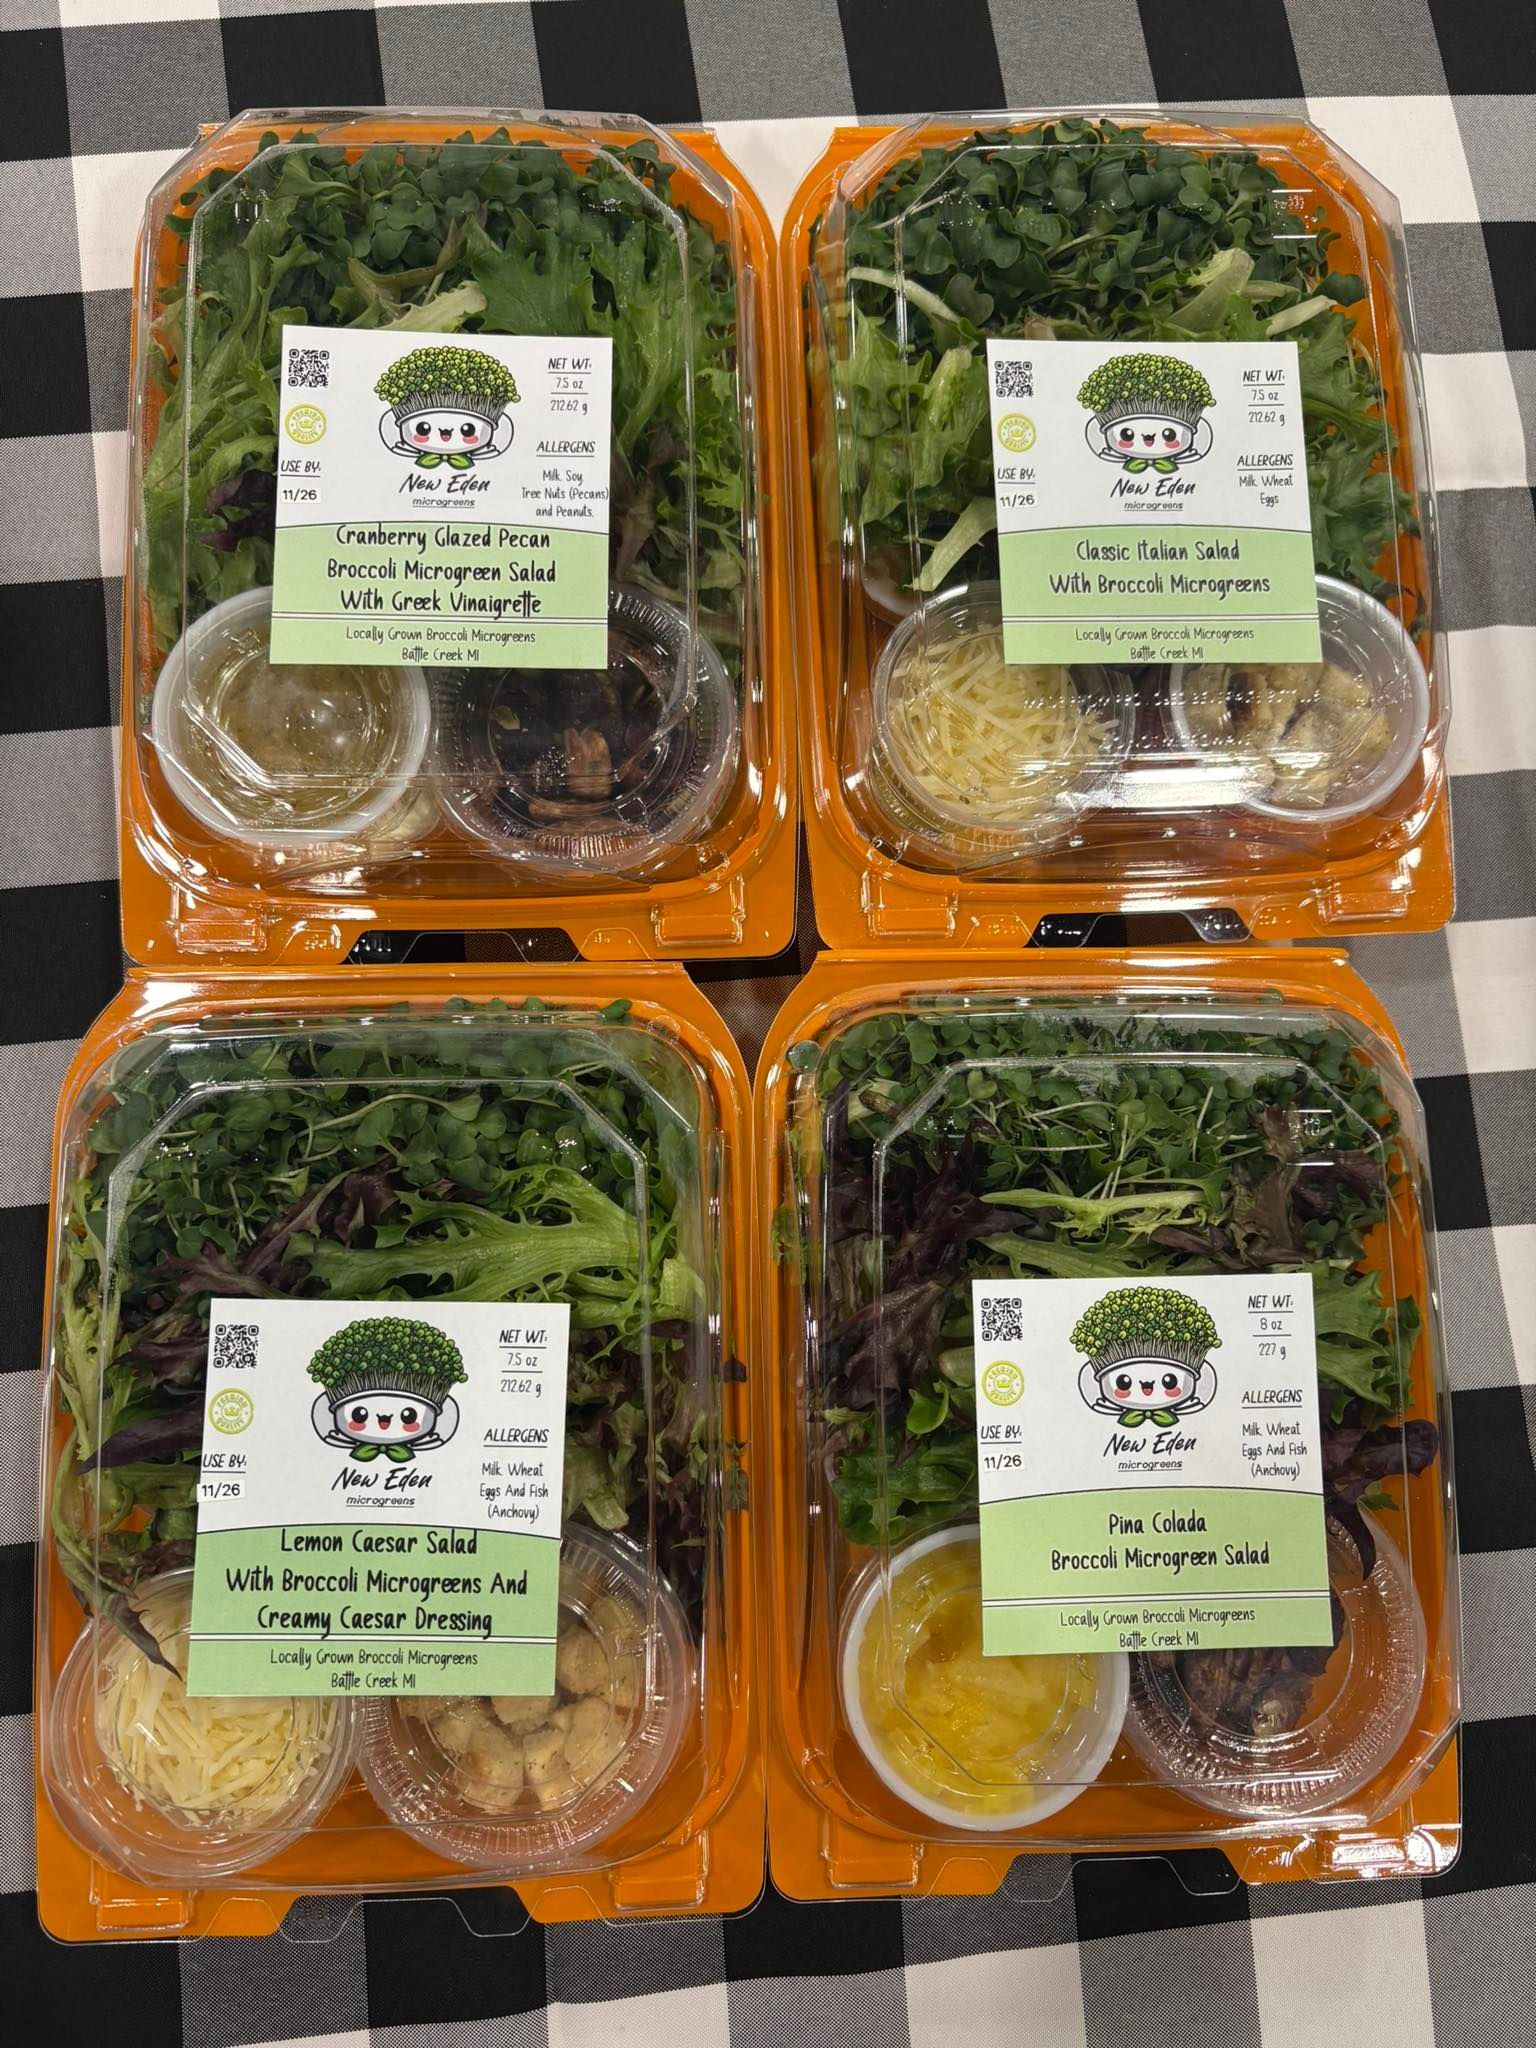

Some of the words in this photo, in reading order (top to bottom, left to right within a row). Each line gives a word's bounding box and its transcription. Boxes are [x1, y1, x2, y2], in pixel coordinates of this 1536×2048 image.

[549, 359, 567, 370] NET
[1243, 370, 1261, 382] NET
[572, 379, 583, 390] oz
[1269, 391, 1279, 401] oz
[551, 400, 579, 411] 212.62
[582, 403, 588, 415] g
[1249, 412, 1276, 423] 212.62
[1279, 414, 1285, 426] g
[537, 441, 595, 453] ALLERGENS
[281, 460, 301, 472] USE
[1237, 454, 1293, 467] ALLERGENS
[998, 468, 1016, 479] USE
[1261, 474, 1293, 487] Wheat
[399, 474, 441, 493] New
[447, 474, 490, 494] Eden
[1110, 478, 1150, 498] New
[1155, 478, 1195, 496] Eden
[283, 489, 317, 501] 11/26
[522, 487, 541, 499] Tree
[545, 488, 566, 500] Nuts
[569, 487, 609, 501] (Pecans)
[1000, 495, 1034, 507] 11/26
[1260, 493, 1279, 507] Eggs
[412, 497, 475, 508] microgreens
[1124, 502, 1183, 511] microgreens
[536, 506, 553, 516] and
[336, 525, 427, 554] Cranberry
[435, 526, 491, 548] Glazed
[499, 530, 550, 548] Pecan
[1076, 541, 1130, 561] Classic
[1138, 541, 1188, 561] Italian
[1195, 540, 1239, 561] Salad
[328, 559, 396, 579] Broccoli
[405, 562, 501, 588] Microgreen
[509, 562, 556, 582] Salad
[1050, 574, 1091, 593] With
[1098, 574, 1163, 593] Broccoli
[1171, 576, 1270, 600] Microgreens
[341, 590, 383, 610] With
[392, 592, 442, 612] Greek
[450, 592, 541, 619] Vinaigrette
[346, 627, 383, 645] Locally
[388, 629, 422, 641] Grown
[427, 629, 468, 642] Broccoli
[472, 630, 536, 646] Microgreens
[1076, 628, 1111, 645] Locally
[1115, 628, 1147, 640] Grown
[1151, 628, 1190, 640] Broccoli
[1194, 628, 1254, 643] Microgreens
[402, 649, 429, 662] Battle
[433, 650, 463, 661] Creek
[467, 650, 480, 661] MI
[1130, 648, 1156, 661] Battle
[1160, 648, 1188, 659] Creek
[1192, 648, 1203, 659] MI
[1248, 1296, 1267, 1308] NET
[1260, 1319, 1267, 1330] 8
[1272, 1320, 1283, 1330] oz
[500, 1329, 520, 1343] NET
[1259, 1343, 1276, 1356] 227
[1280, 1346, 1286, 1359] g
[526, 1356, 537, 1367] oz
[501, 1380, 532, 1393] 212.62
[536, 1384, 542, 1398] g
[1242, 1390, 1303, 1403] ALLERGENS
[483, 1429, 549, 1443] ALLERGENS
[981, 1426, 1001, 1439] USE
[1266, 1422, 1300, 1436] Wheat
[1103, 1434, 1147, 1456] New
[1153, 1432, 1198, 1454] Eden
[1242, 1443, 1262, 1459] Eggs
[1266, 1444, 1286, 1455] And
[1289, 1443, 1308, 1455] Fish
[203, 1455, 227, 1467] USE
[984, 1454, 1021, 1469] 11/26
[1118, 1460, 1183, 1470] microgreens
[508, 1463, 544, 1477] Wheat
[1251, 1464, 1300, 1480] (Anchovy)
[331, 1467, 379, 1490] New
[384, 1467, 432, 1490] Eden
[202, 1483, 240, 1497] 11/26
[480, 1484, 501, 1501] Eggs
[504, 1486, 525, 1497] And
[529, 1485, 548, 1498] Fish
[346, 1496, 415, 1507] microgreens
[487, 1505, 540, 1520] (Anchovy)
[1109, 1514, 1144, 1535] Pina
[1152, 1510, 1207, 1534] Colada
[281, 1529, 343, 1552] Lemon
[352, 1530, 417, 1552] Caesar
[427, 1530, 477, 1554] Salad
[1052, 1549, 1118, 1571] Broccoli
[1125, 1548, 1217, 1575] Microgreen
[1225, 1542, 1269, 1565] Salad
[226, 1568, 273, 1591] With
[282, 1568, 357, 1592] Broccoli
[367, 1570, 481, 1602] Microgreens
[490, 1571, 527, 1594] And
[257, 1606, 331, 1639] Creamy
[340, 1607, 406, 1629] Caesar
[416, 1610, 492, 1638] Dressing
[1061, 1611, 1099, 1631] Locally
[1104, 1612, 1139, 1625] Grown
[1143, 1610, 1185, 1624] Broccoli
[1189, 1609, 1255, 1627] Microgreens
[1120, 1633, 1147, 1650] Battle
[1152, 1633, 1182, 1646] Creek
[1187, 1633, 1199, 1646] MI
[271, 1648, 312, 1669] Locally
[316, 1650, 354, 1663] Grown
[358, 1650, 403, 1664] Broccoli
[408, 1651, 478, 1669] Microgreens
[331, 1673, 361, 1690] Battle
[366, 1673, 398, 1687] Creek
[403, 1674, 416, 1688] MI
